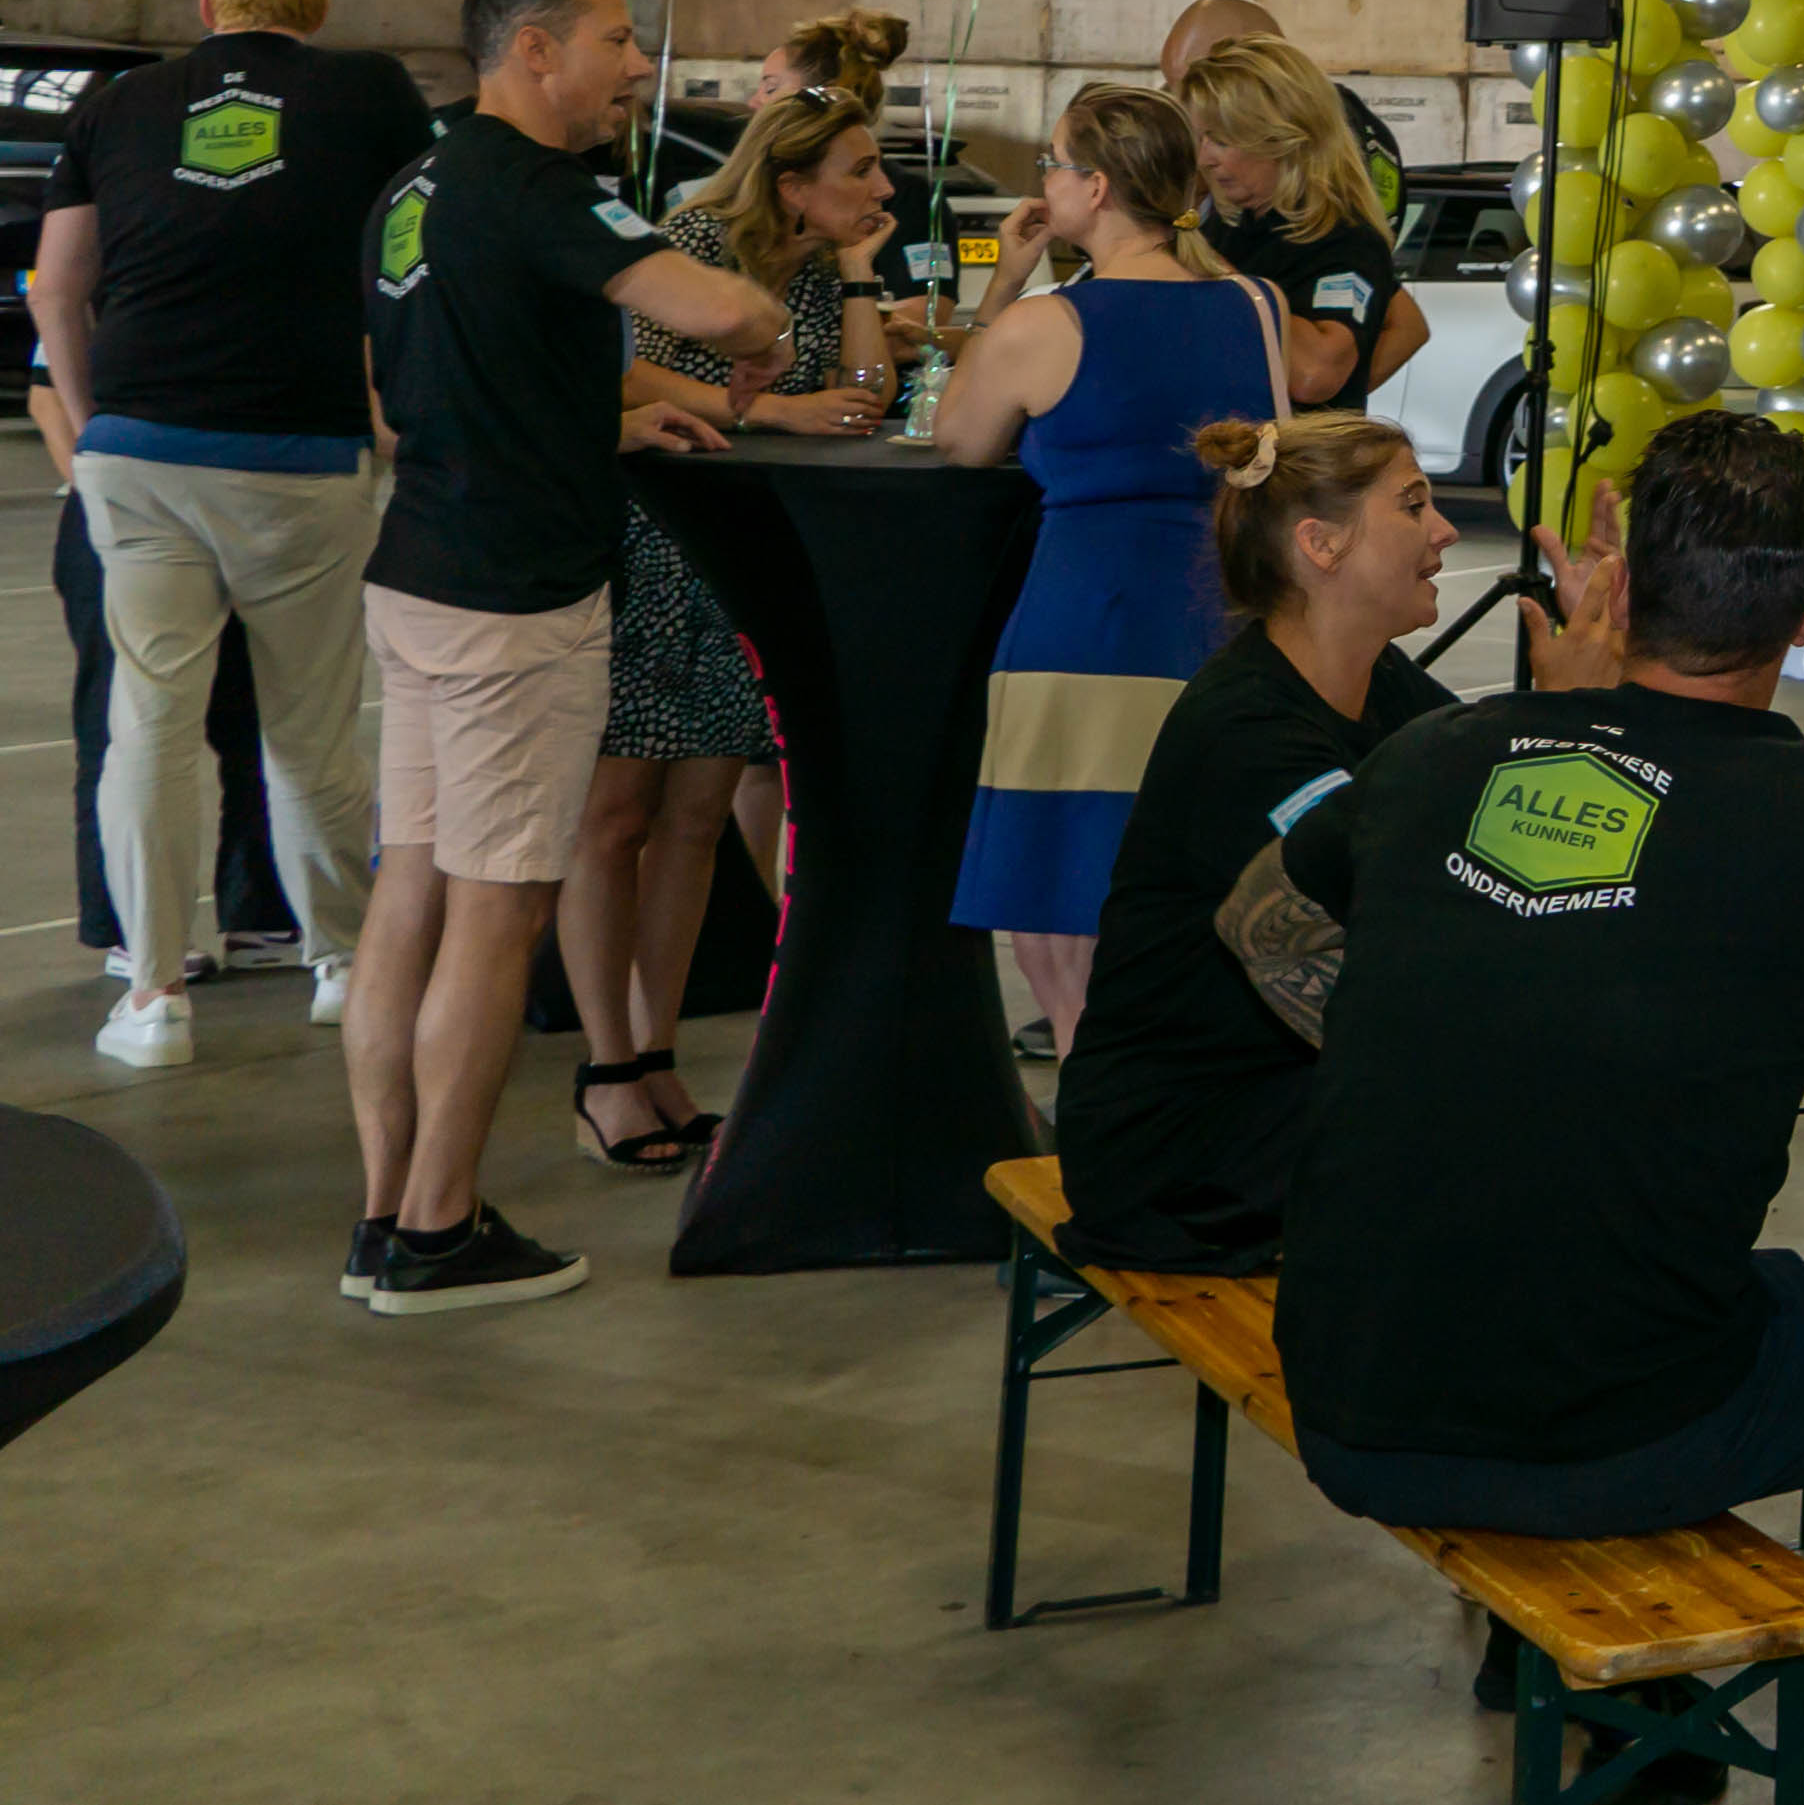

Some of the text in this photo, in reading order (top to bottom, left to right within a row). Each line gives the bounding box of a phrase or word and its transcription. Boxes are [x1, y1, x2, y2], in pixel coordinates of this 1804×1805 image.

[194, 121, 266, 141] ALLES
[1509, 736, 1674, 796] WESTFRIESE
[1495, 783, 1631, 834] ALLES
[1510, 818, 1598, 851] KUNNER
[1445, 851, 1638, 918] ONDERNEMER
